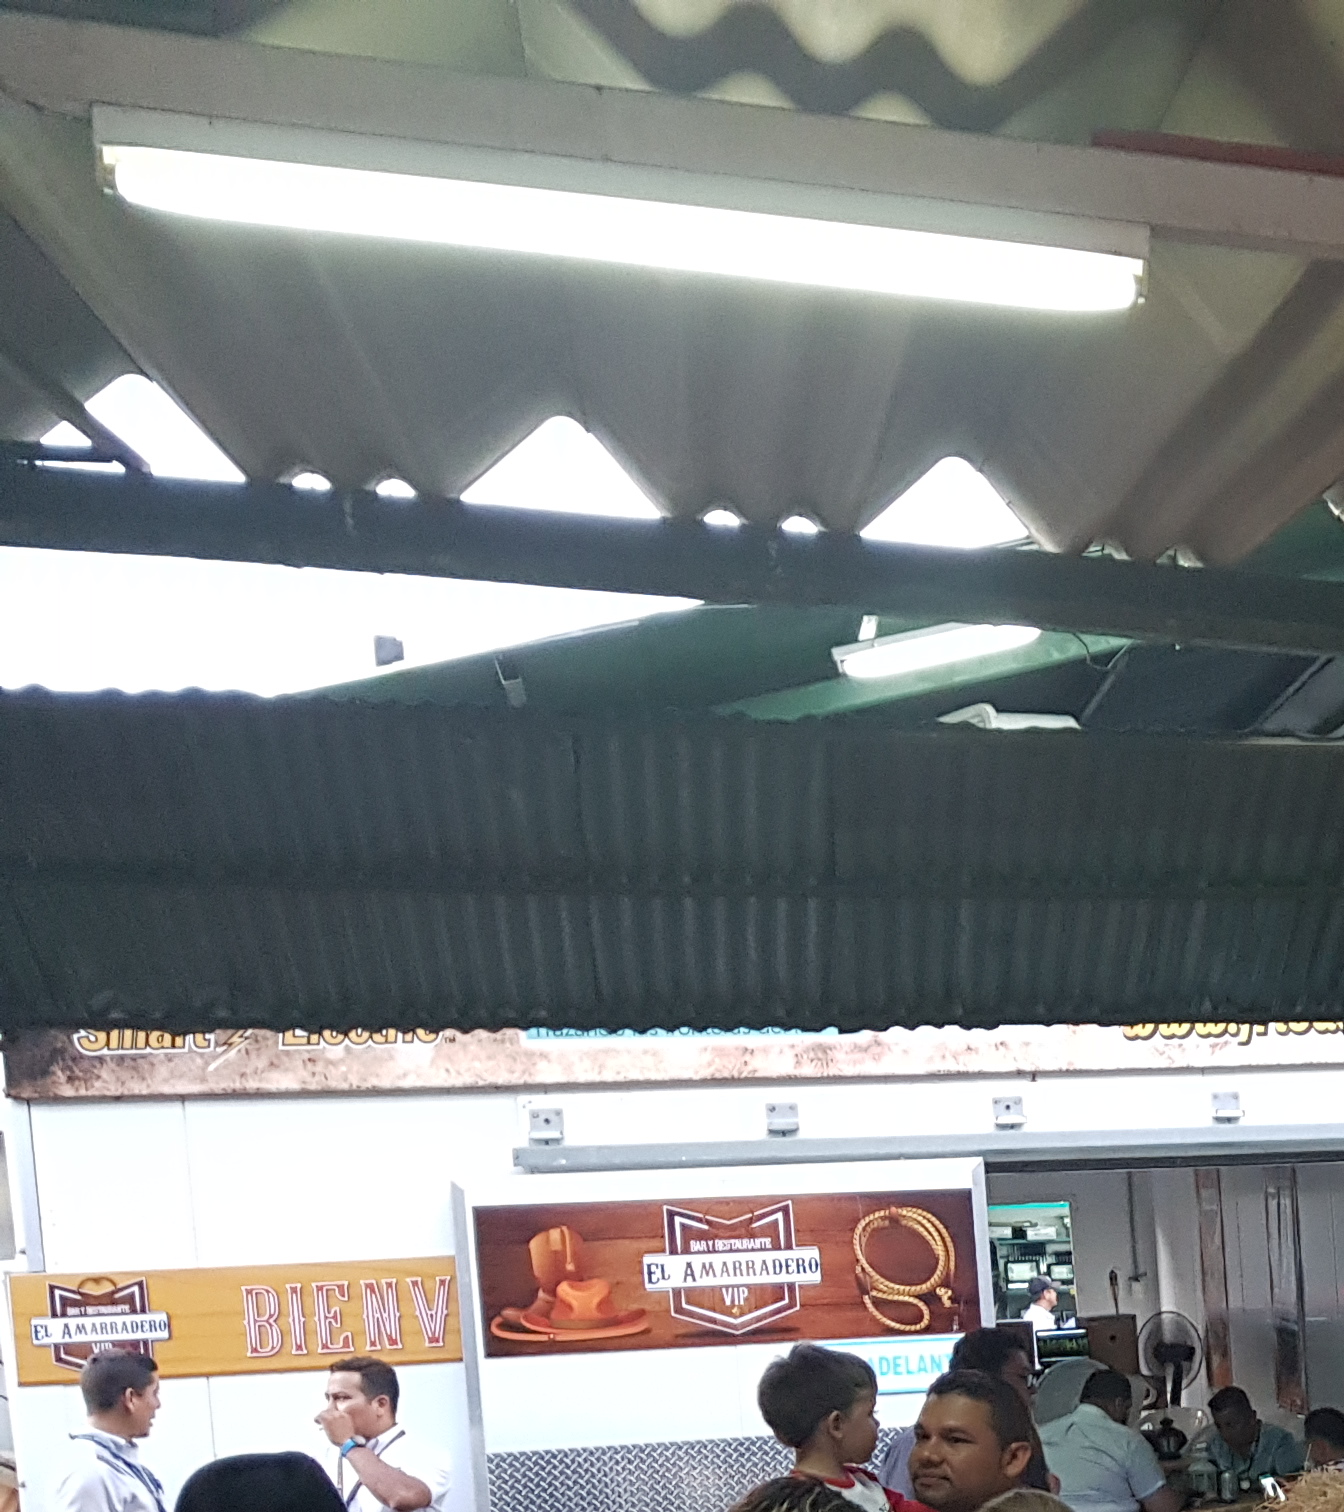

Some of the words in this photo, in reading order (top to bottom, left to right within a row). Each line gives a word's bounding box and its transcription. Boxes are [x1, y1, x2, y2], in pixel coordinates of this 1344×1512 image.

[646, 1262, 671, 1285] EL
[682, 1257, 819, 1283] AMARRADERO
[722, 1287, 749, 1306] VIP
[62, 1318, 168, 1340] AMARRADERO
[241, 1276, 450, 1357] BIENV
